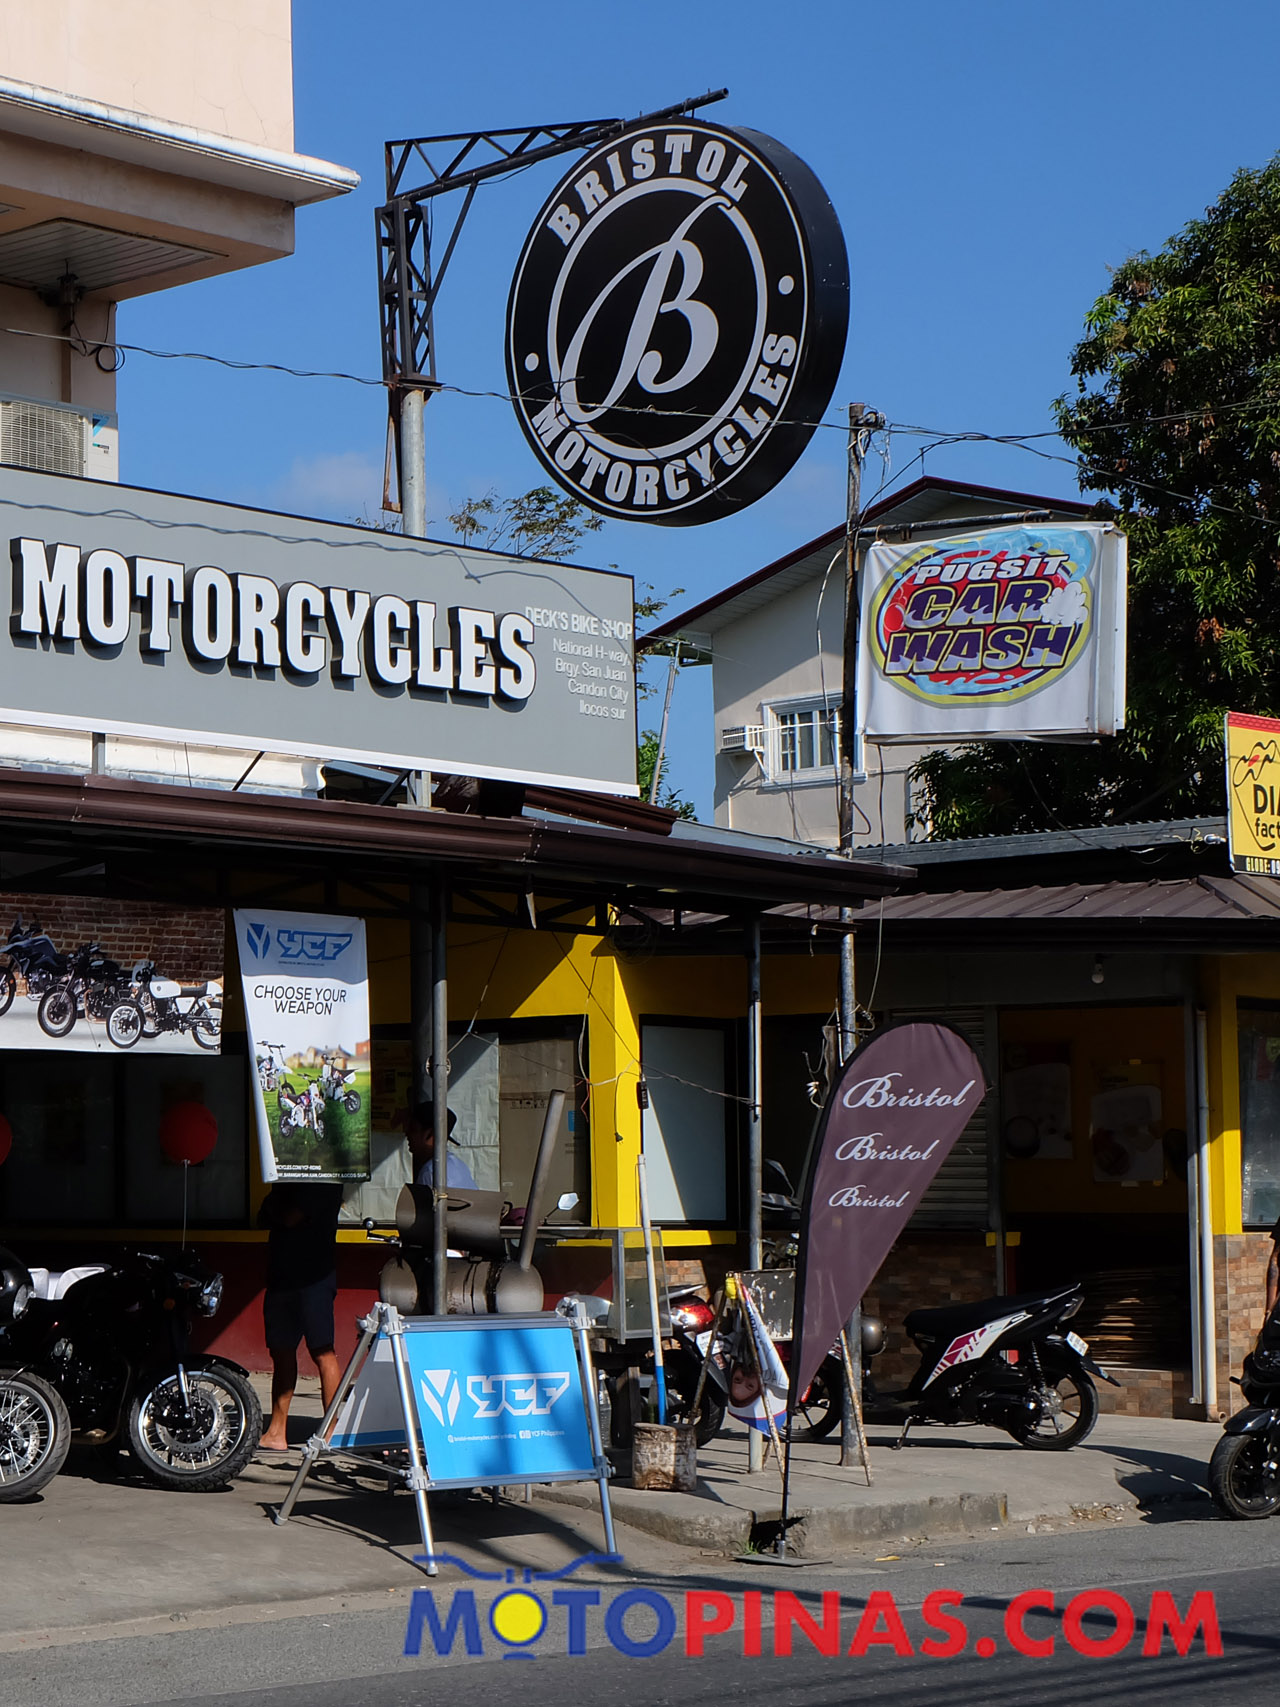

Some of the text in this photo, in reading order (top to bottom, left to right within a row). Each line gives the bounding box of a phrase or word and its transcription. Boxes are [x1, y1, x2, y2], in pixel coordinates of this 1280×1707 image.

[547, 133, 751, 247] BRISTOL
[531, 333, 797, 506] MOTORCYCLES
[912, 553, 1070, 585] PUGSIT
[9, 536, 537, 701] MOTORCYCLES
[903, 578, 1053, 630] CAR
[525, 606, 632, 641] DECK'S BIKE SHOP
[553, 638, 593, 658] National
[884, 623, 1079, 676] WASH
[582, 661, 601, 678] San
[603, 665, 627, 682] Juan
[568, 678, 629, 704] Candon City
[610, 708, 627, 720] sur
[1253, 783, 1280, 817] DI
[254, 984, 347, 1003] CHOOSE YOUR
[274, 1000, 333, 1016] WEAPON
[843, 1072, 976, 1109] Bristol
[835, 1132, 940, 1161] Bristol
[828, 1184, 910, 1208] Bristol
